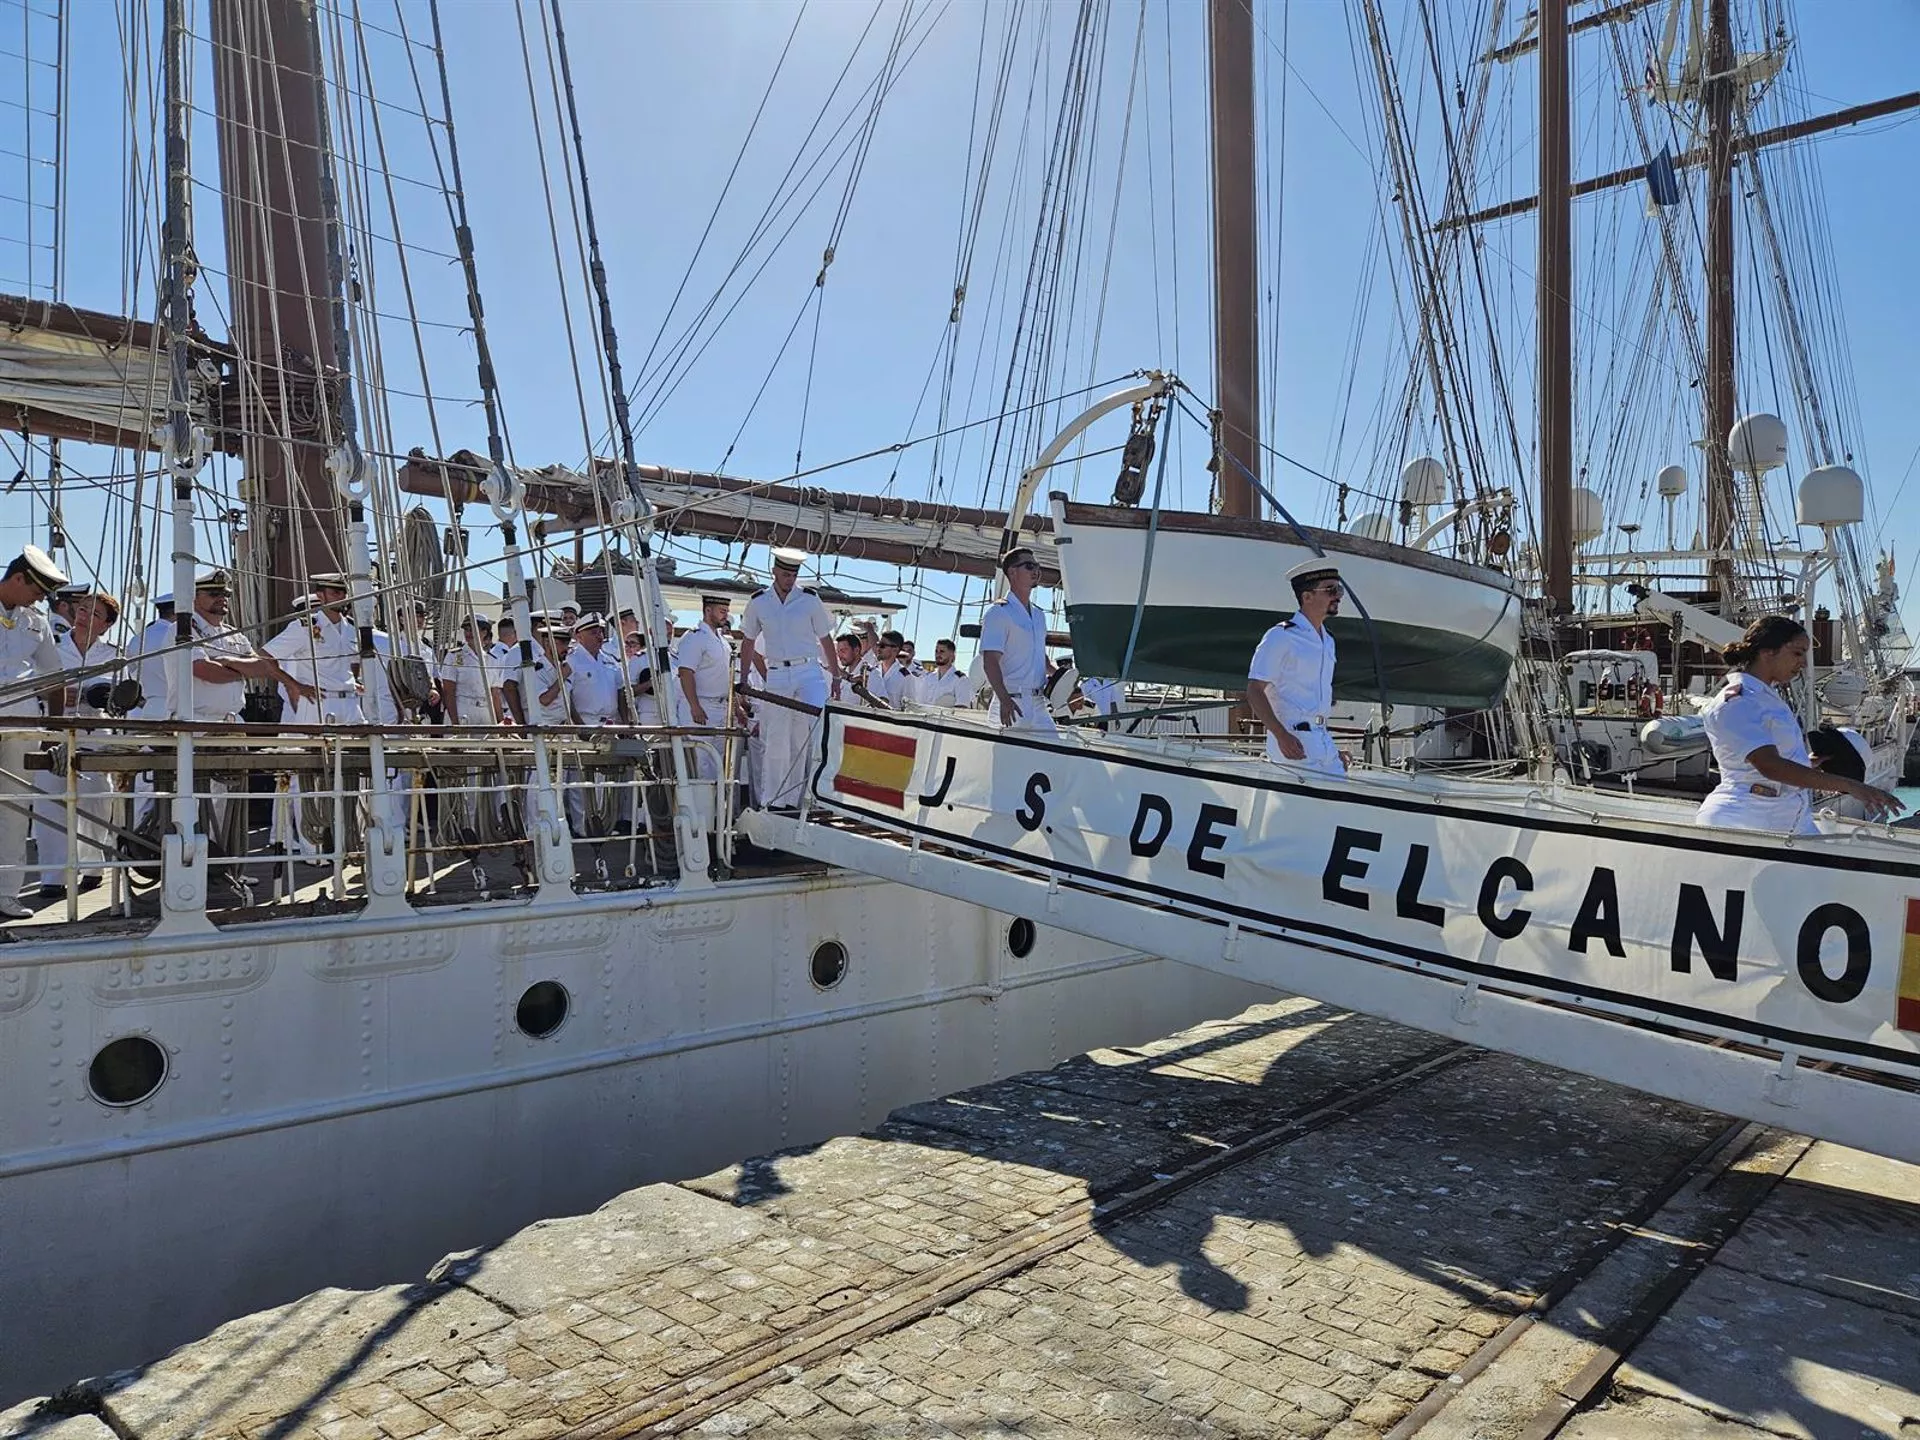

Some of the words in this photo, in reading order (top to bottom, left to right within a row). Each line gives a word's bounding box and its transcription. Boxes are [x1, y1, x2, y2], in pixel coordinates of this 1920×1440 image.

[918, 756, 957, 812] J.
[1015, 772, 1053, 835] S.
[1128, 792, 1238, 880] DE
[1321, 825, 1872, 1004] ELCANO
